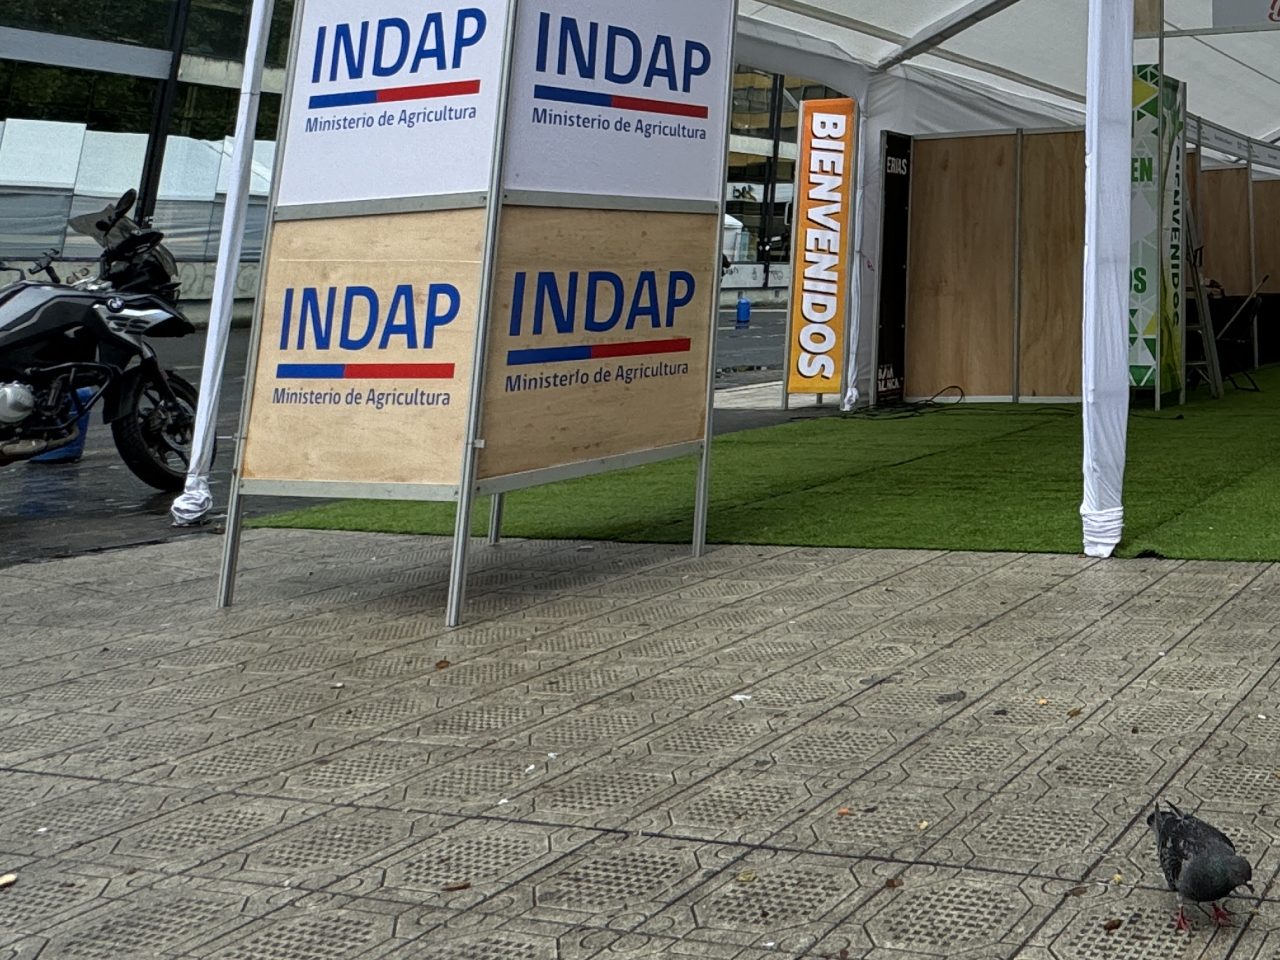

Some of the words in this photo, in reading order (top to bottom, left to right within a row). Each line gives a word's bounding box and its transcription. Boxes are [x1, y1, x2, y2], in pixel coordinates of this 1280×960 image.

[312, 7, 487, 83] INDAP
[536, 11, 711, 93] INDAP
[305, 112, 374, 133] Ministerio
[378, 111, 395, 126] de
[398, 105, 477, 128] Agricultura
[532, 107, 610, 130] Ministerio
[614, 117, 631, 132] de
[634, 119, 706, 139] Agricultura
[797, 112, 847, 379] BIENVENIDOS
[279, 283, 461, 351] INDAP
[509, 270, 696, 336] INDAP
[272, 387, 341, 405] Ministerio
[345, 387, 362, 404] de
[365, 387, 450, 410] Agricultura
[505, 368, 589, 392] Ministerio
[593, 367, 611, 383] de
[615, 361, 689, 384] Agricultura
